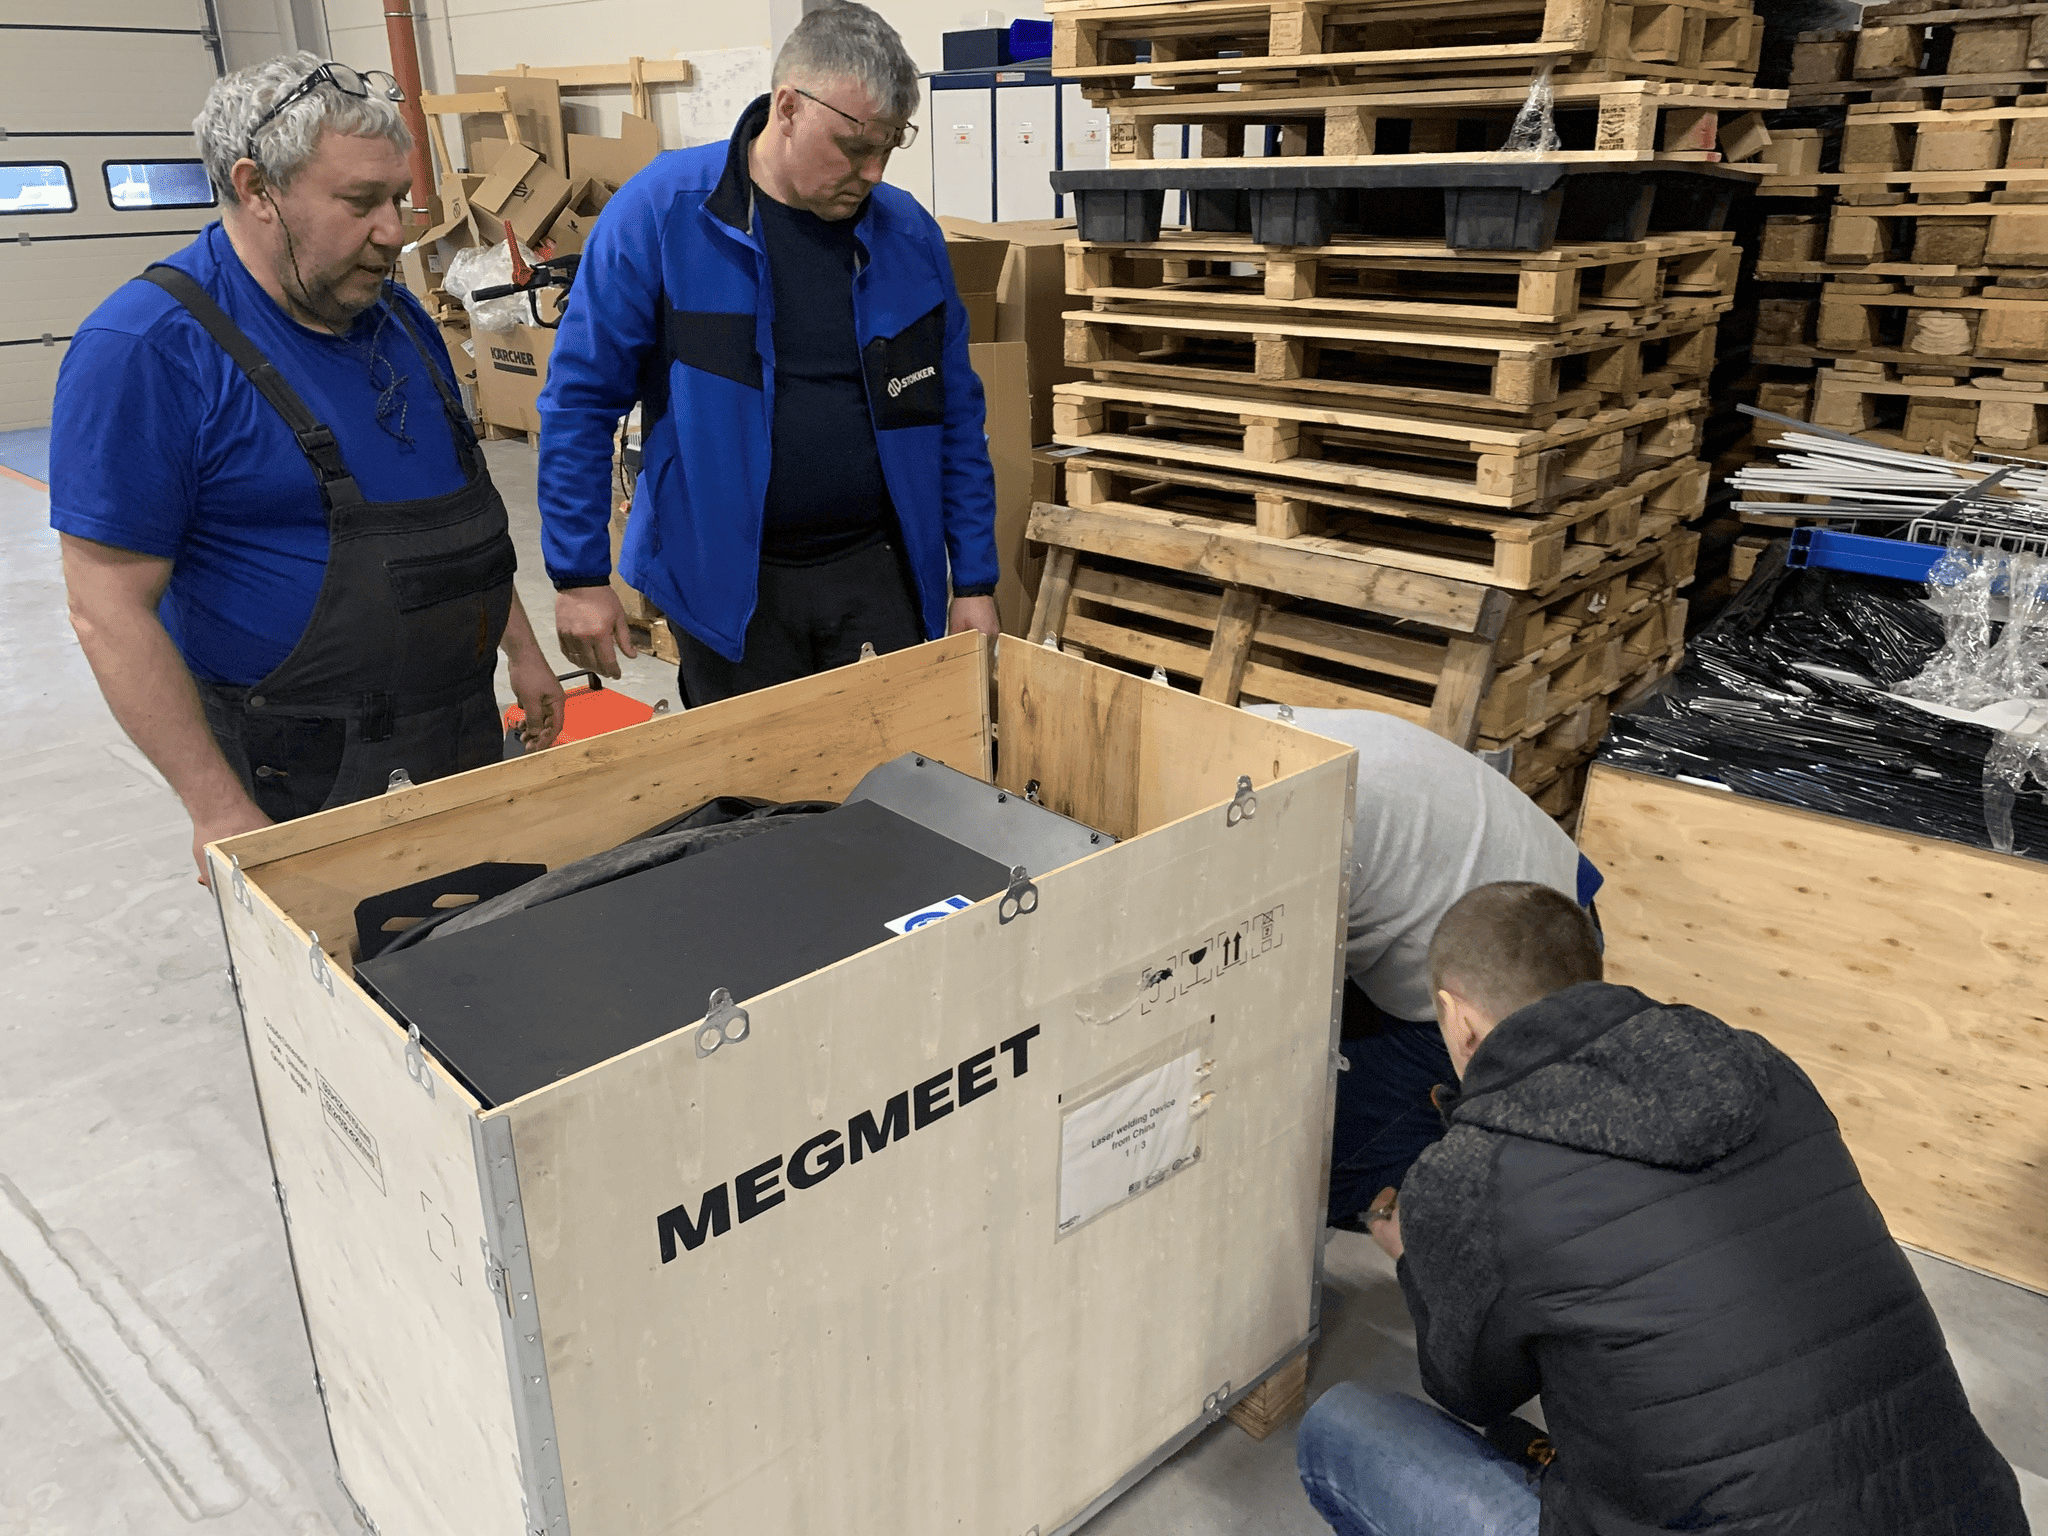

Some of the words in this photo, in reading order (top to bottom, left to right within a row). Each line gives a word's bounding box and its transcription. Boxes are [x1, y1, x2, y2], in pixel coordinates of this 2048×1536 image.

[901, 366, 936, 388] STOKKER
[1091, 1130, 1115, 1149] Laser
[1116, 1113, 1148, 1135] welding
[1149, 1099, 1176, 1117] Device
[1111, 1135, 1131, 1150] from
[1132, 1122, 1156, 1139] China
[657, 1023, 1040, 1264] MEGMEET
[1125, 1148, 1130, 1157] 1
[1140, 1140, 1146, 1150] 3
